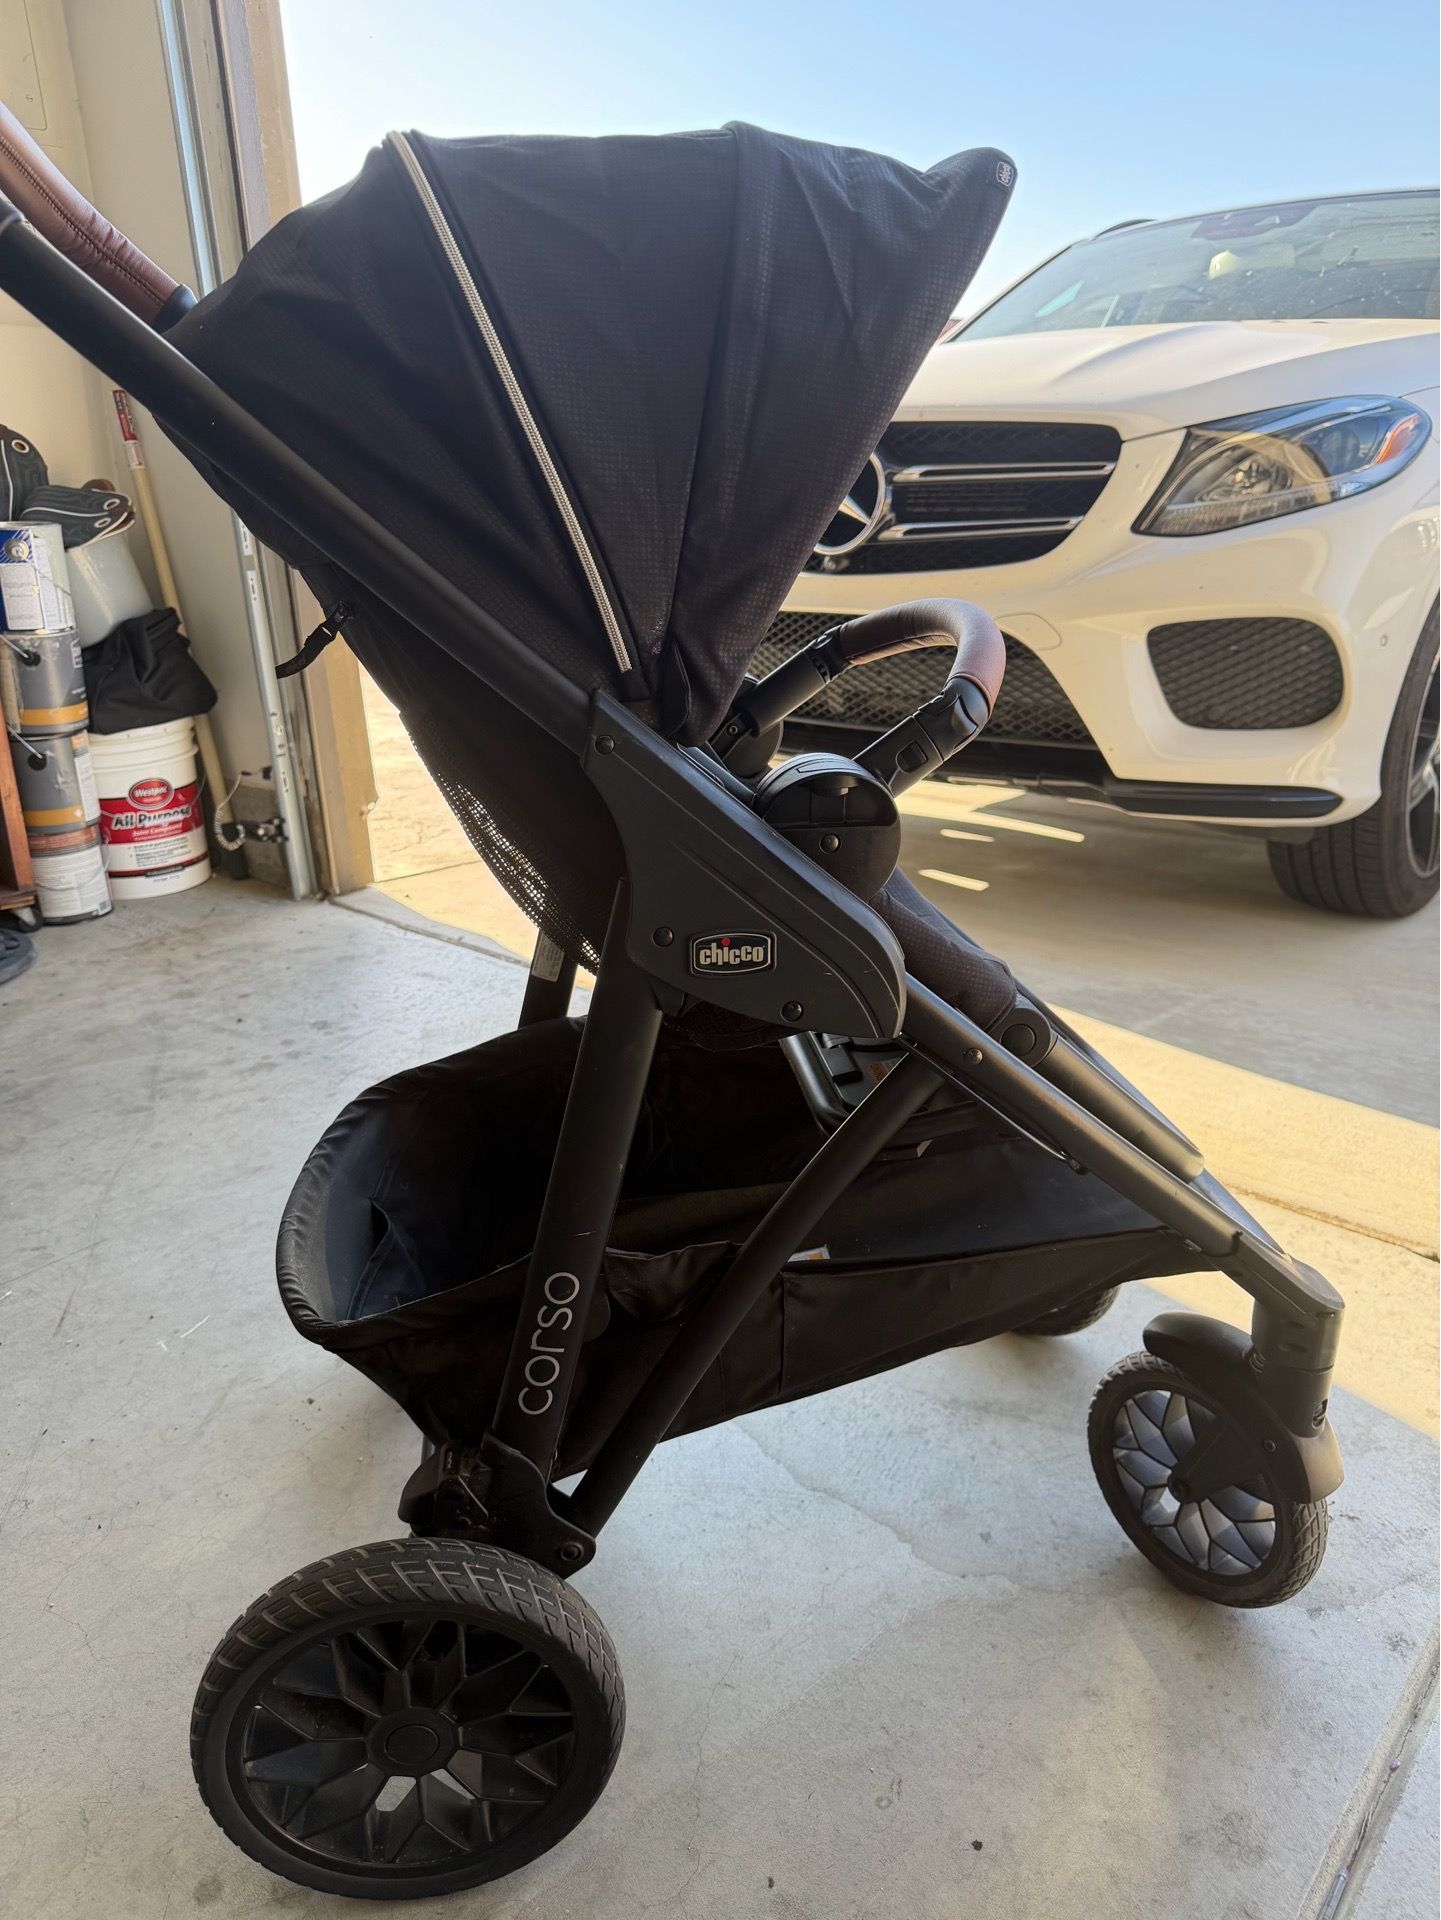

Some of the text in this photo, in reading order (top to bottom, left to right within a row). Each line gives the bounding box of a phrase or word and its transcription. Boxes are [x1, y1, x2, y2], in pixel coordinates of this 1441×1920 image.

[113, 815, 134, 828] All
[699, 937, 765, 966] chicco
[517, 1271, 580, 1416] corso
